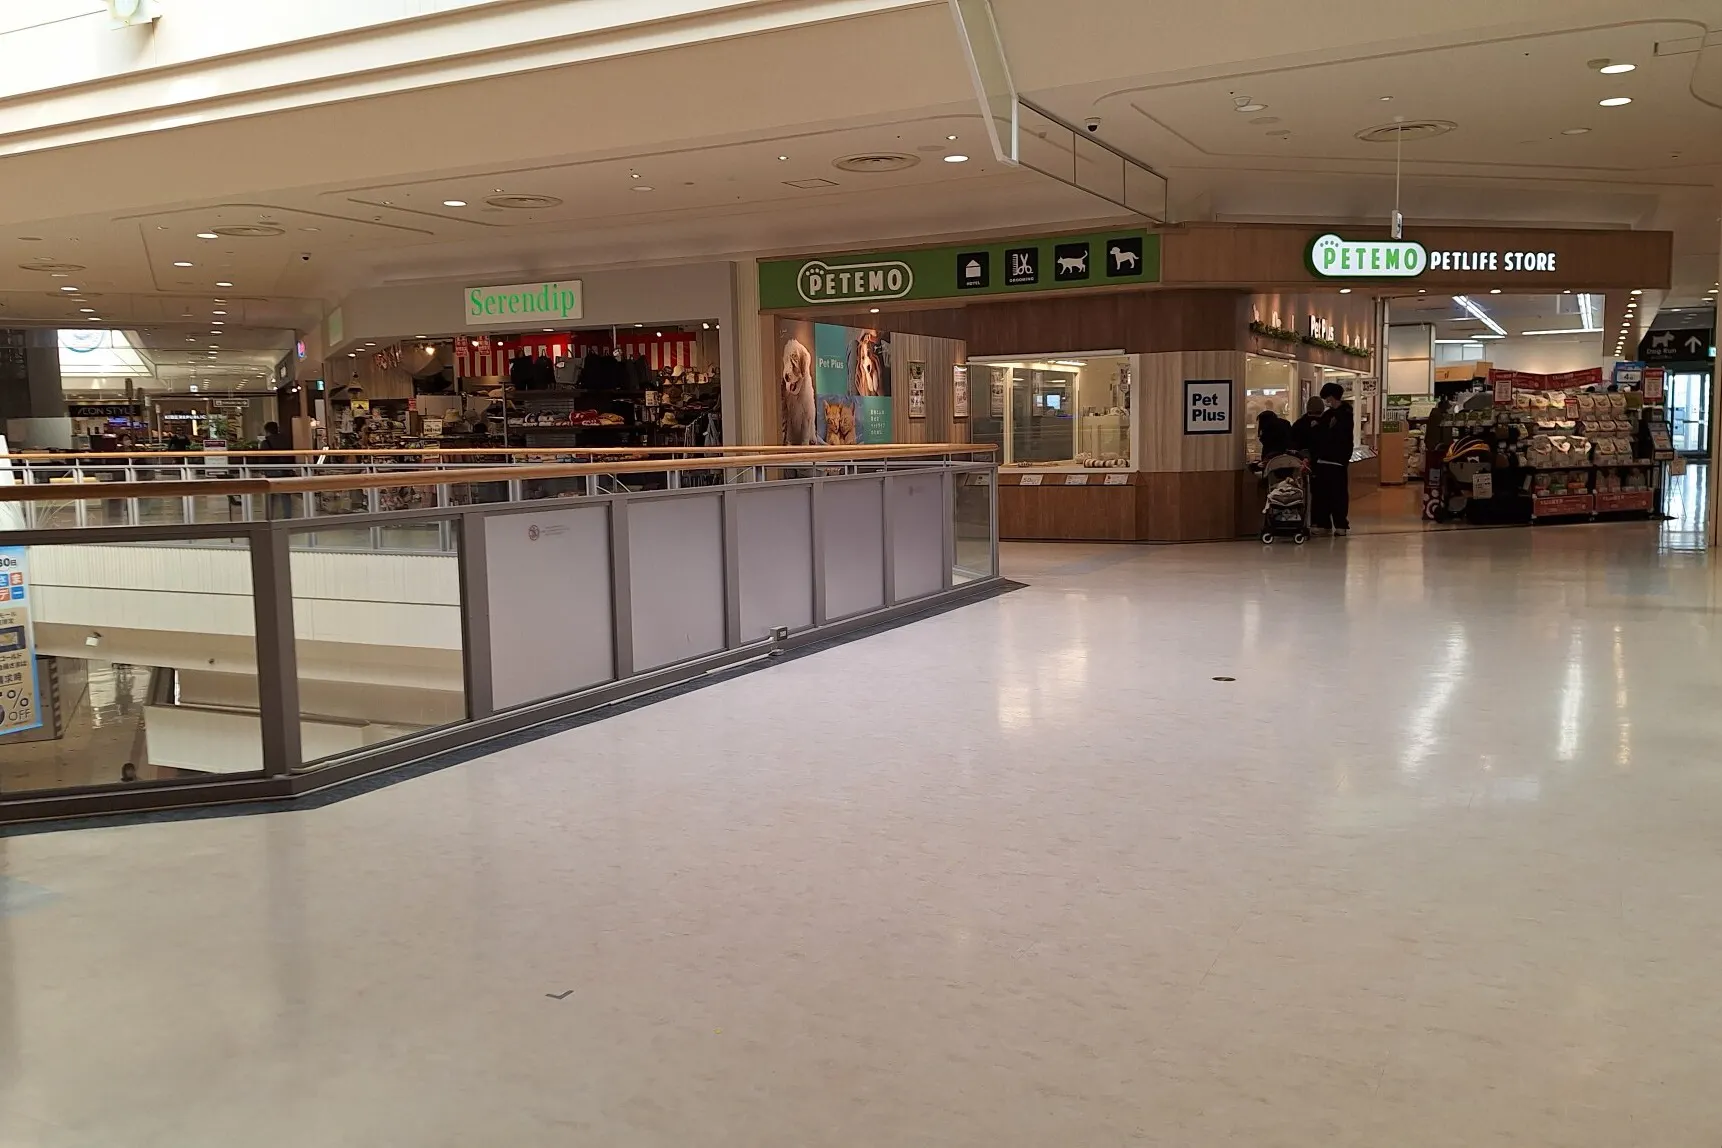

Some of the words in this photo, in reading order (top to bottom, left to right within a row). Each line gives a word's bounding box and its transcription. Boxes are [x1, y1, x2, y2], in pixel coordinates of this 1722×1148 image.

[1324, 247, 1418, 270] PETEMO
[1430, 252, 1498, 272] PETLIFE
[1504, 252, 1556, 272] STORE
[809, 269, 903, 296] PETEMO
[470, 284, 576, 318] Serendip
[819, 357, 830, 368] Pet
[831, 358, 844, 369] Plus
[1192, 393, 1219, 406] Pet
[1192, 409, 1226, 422] Plus
[8, 708, 31, 721] OFF
